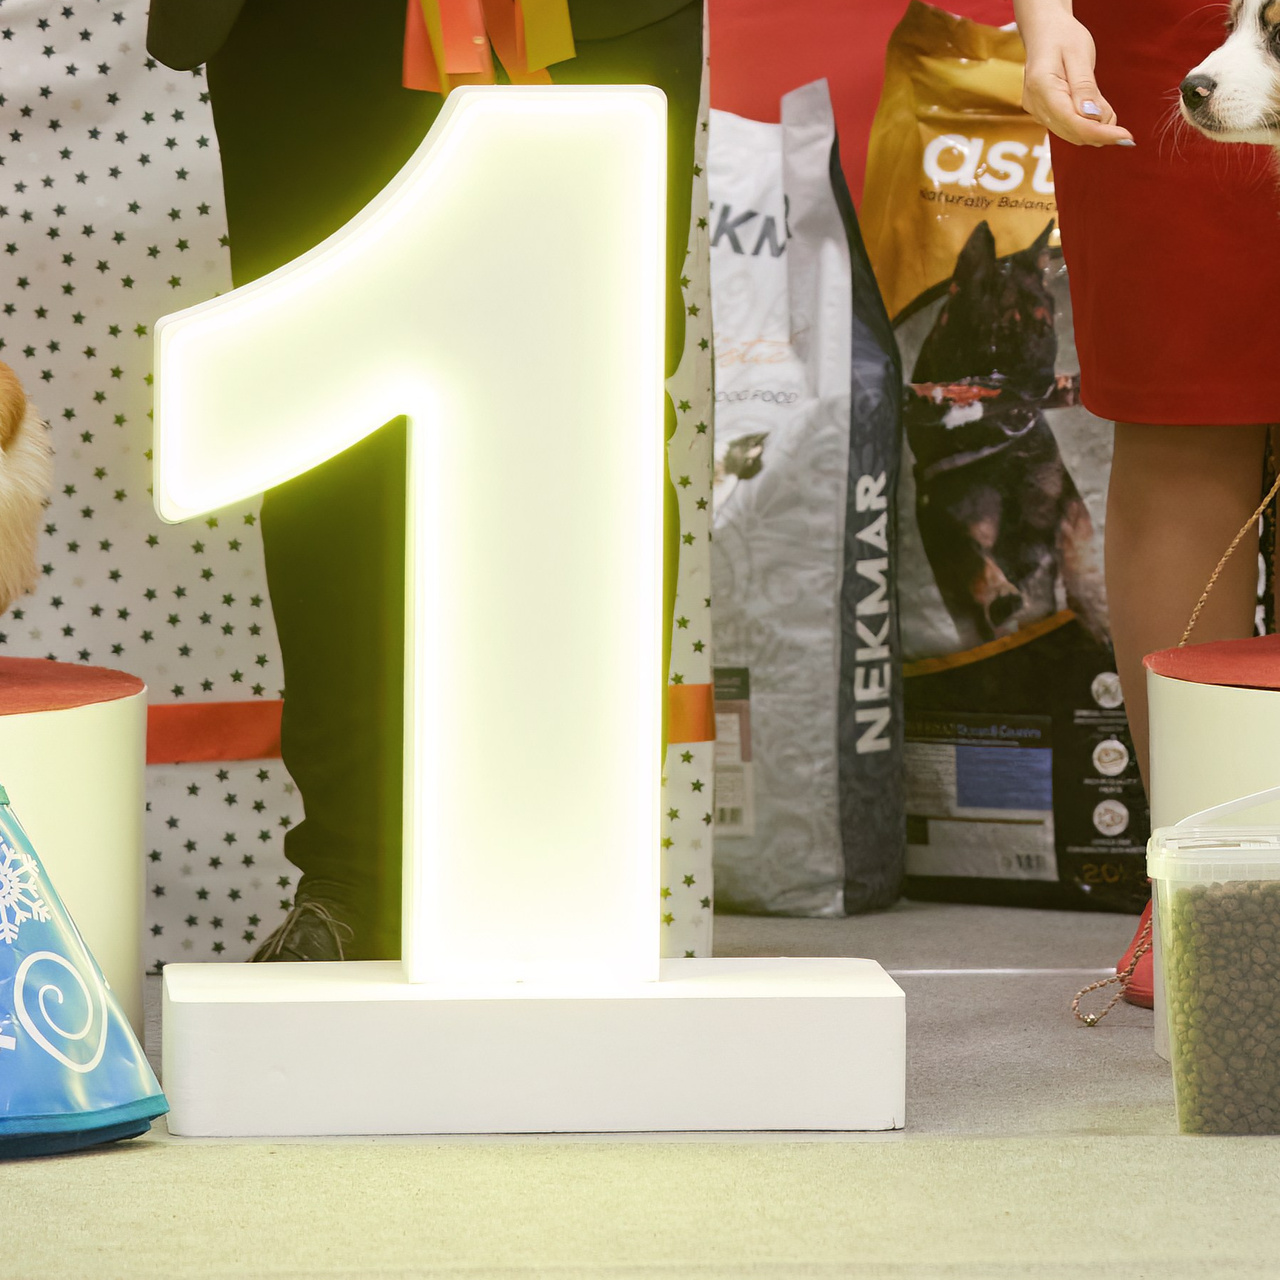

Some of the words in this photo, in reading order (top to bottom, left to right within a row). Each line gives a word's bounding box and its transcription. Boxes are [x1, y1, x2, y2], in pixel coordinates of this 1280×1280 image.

[923, 132, 1055, 195] ast
[997, 196, 1058, 211] Balanc
[152, 84, 670, 984] 1
[855, 470, 892, 754] NEKMAR
